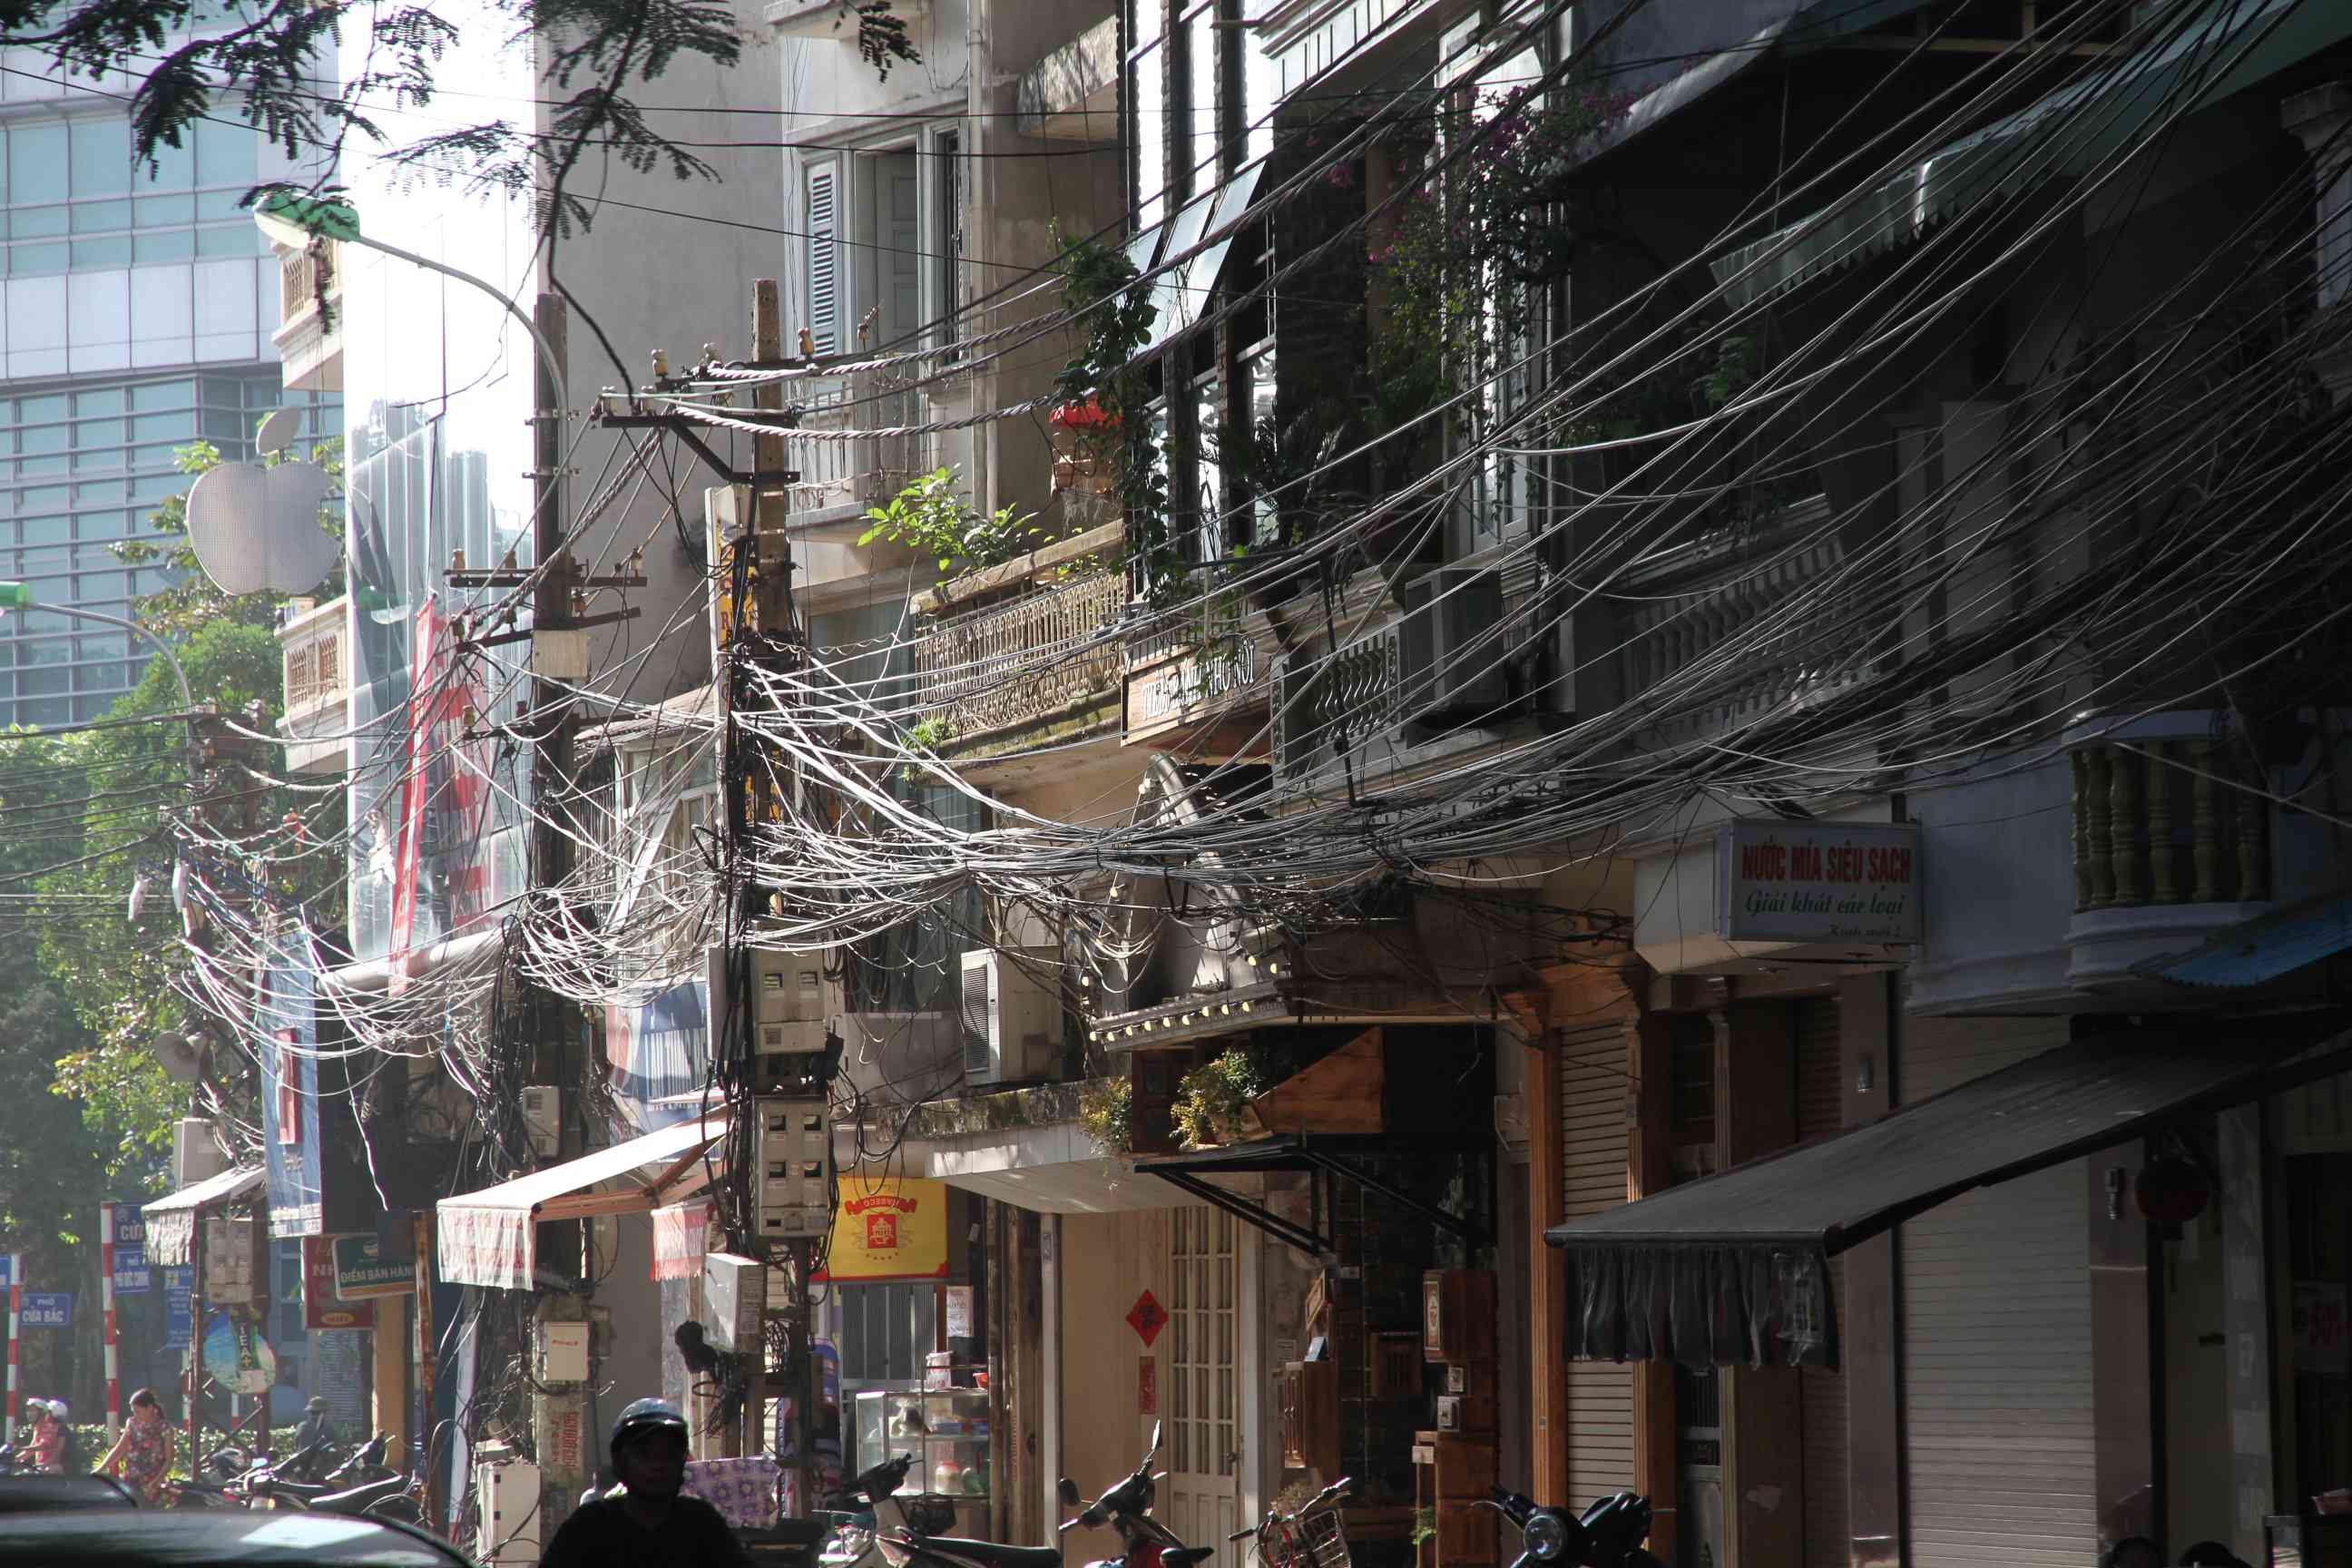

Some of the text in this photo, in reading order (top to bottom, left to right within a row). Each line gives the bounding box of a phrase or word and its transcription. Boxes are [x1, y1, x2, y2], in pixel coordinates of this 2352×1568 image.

[1741, 835, 1786, 880] NƯỚC
[1790, 838, 1822, 880] MÍA
[1868, 847, 1910, 891] SẠCH
[1791, 890, 1833, 914] khát
[1837, 892, 1866, 915] các
[1869, 893, 1906, 922] loại
